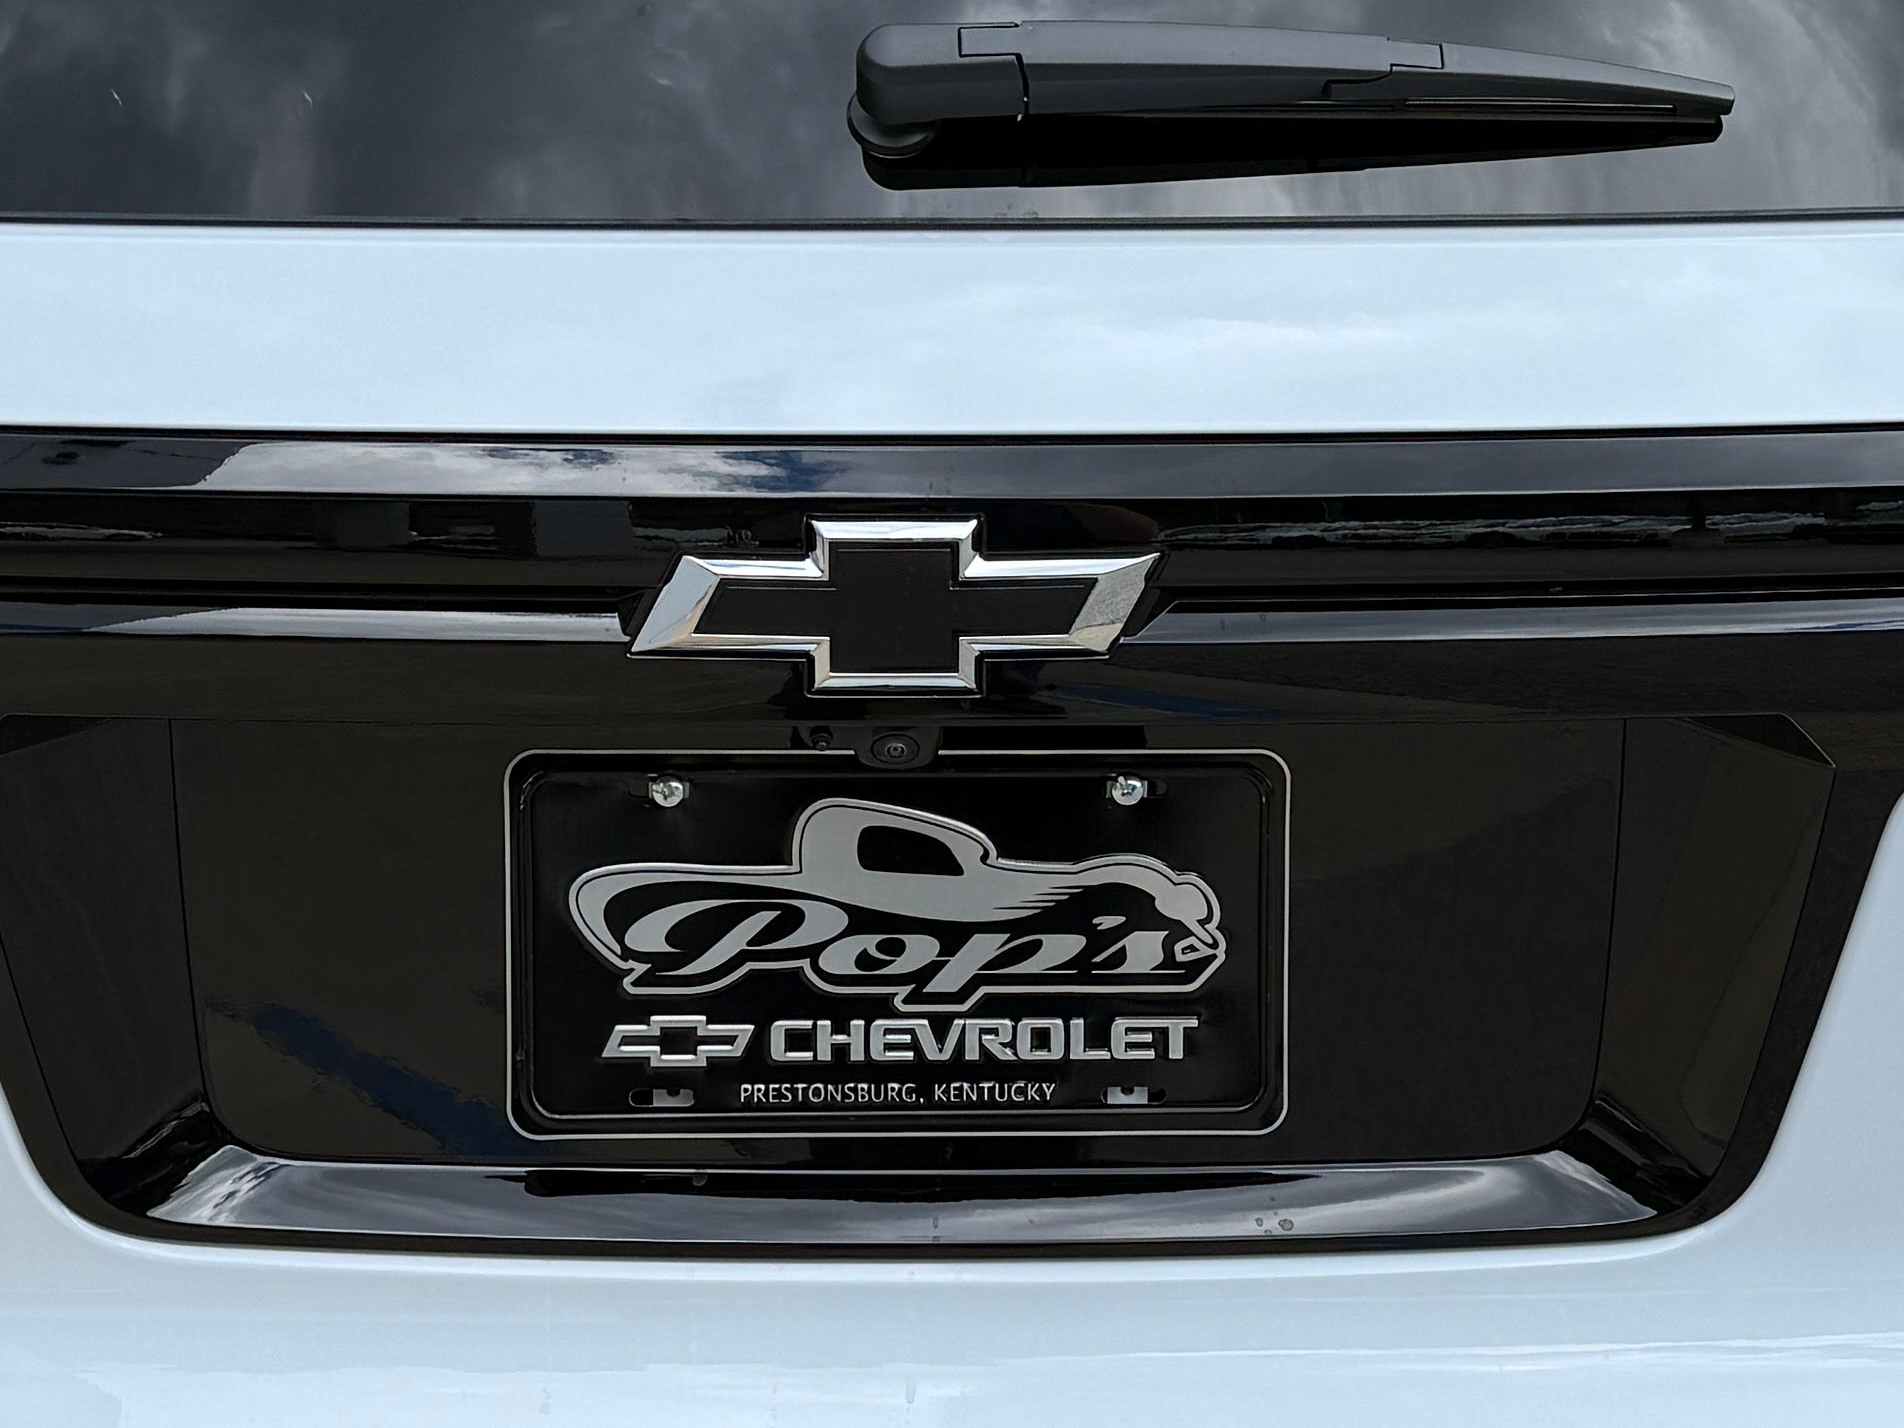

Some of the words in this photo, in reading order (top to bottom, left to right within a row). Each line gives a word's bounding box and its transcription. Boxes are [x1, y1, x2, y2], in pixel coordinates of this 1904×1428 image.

[625, 898, 1193, 994] Pop's
[769, 1017, 1200, 1063] CHEVROLET
[739, 1081, 924, 1106] PRESTONSBURG,
[933, 1081, 1058, 1105] KENTUCKY
